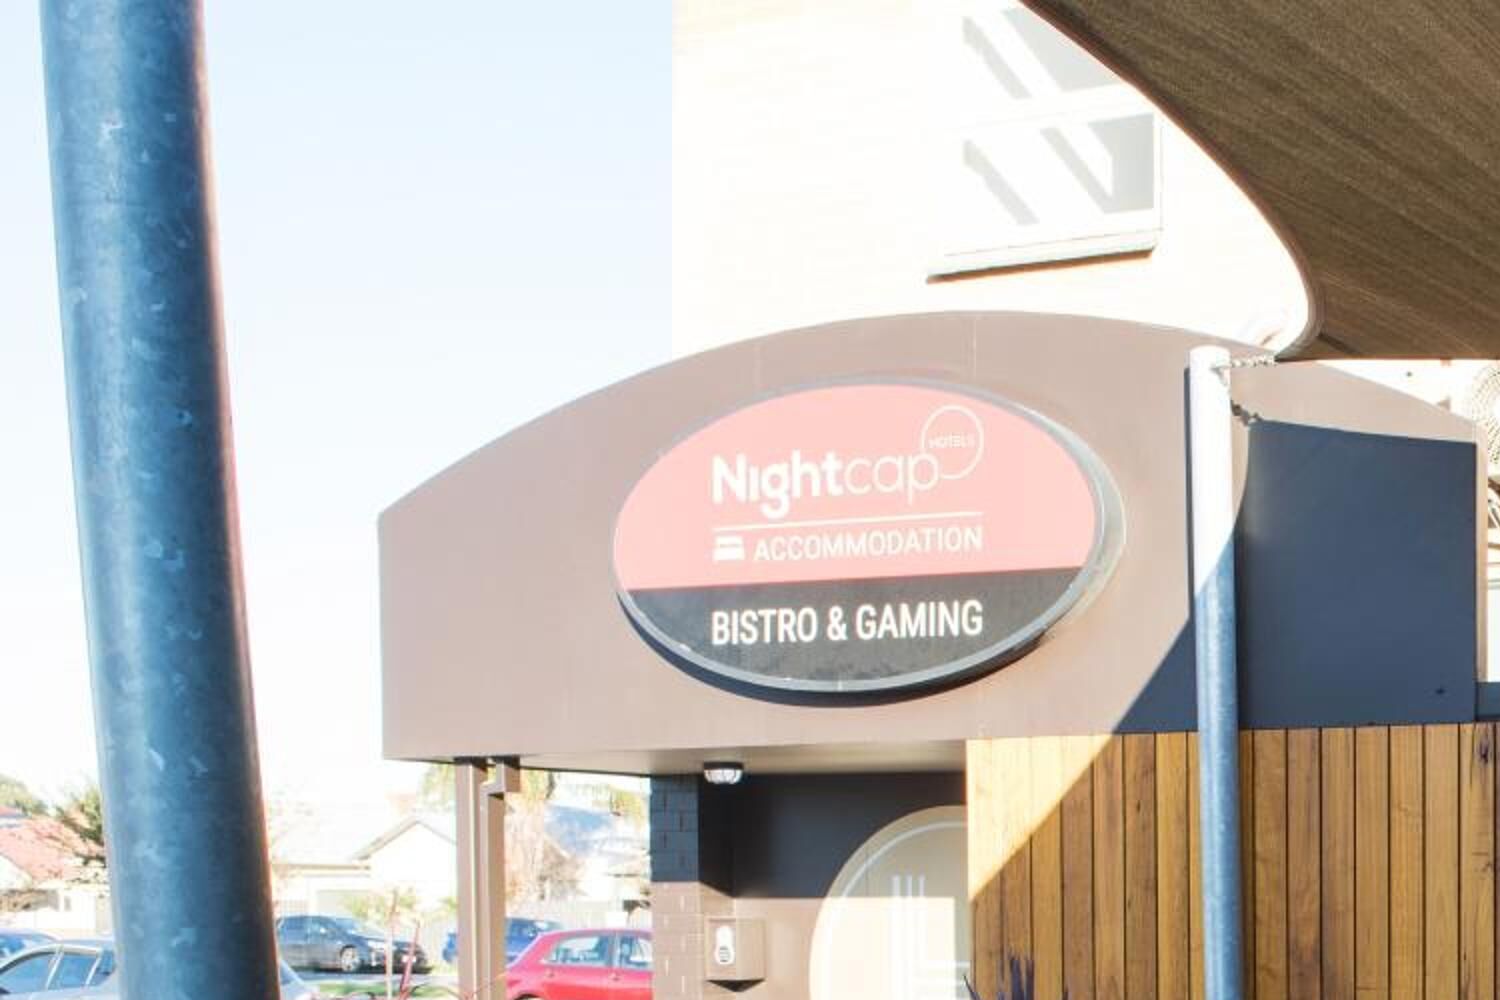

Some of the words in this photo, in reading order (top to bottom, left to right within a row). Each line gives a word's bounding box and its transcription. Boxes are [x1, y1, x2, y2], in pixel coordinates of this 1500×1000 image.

[929, 433, 975, 449] HOTELS
[711, 448, 940, 519] Nightcap
[753, 525, 983, 561] ACCOMMODATION
[711, 606, 818, 646] BISTRO
[826, 605, 848, 641] &
[856, 599, 984, 640] GAMING
